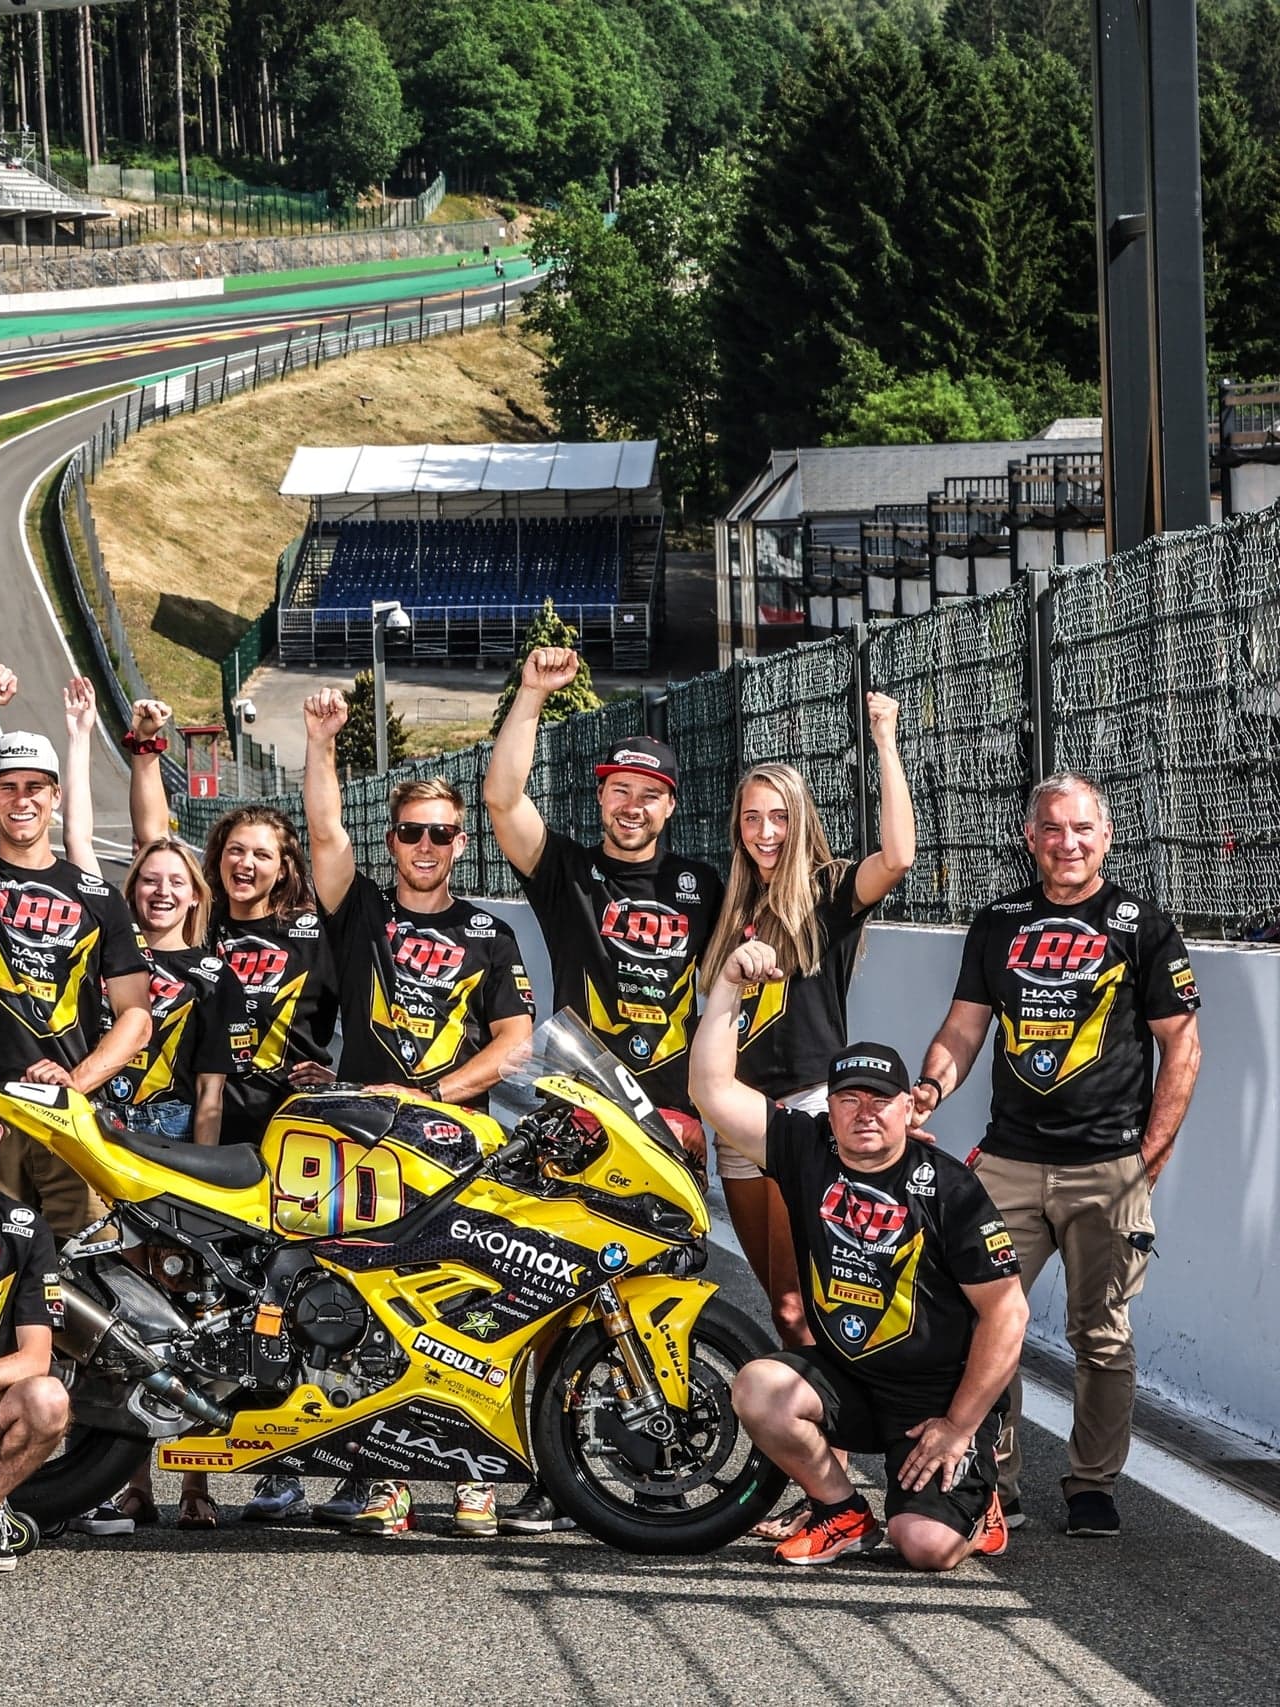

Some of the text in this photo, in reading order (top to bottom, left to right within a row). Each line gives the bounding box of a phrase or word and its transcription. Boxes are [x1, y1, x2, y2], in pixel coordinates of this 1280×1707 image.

[600, 900, 689, 948] LRP
[1019, 925, 1044, 934] team
[42, 934, 76, 948] Poland
[290, 930, 319, 938] PITBULL
[656, 947, 687, 958] Poland
[1006, 932, 1108, 969] LRP
[618, 961, 669, 982] HAAS
[1062, 972, 1099, 982] Poland
[420, 974, 455, 989] Poland
[1022, 988, 1078, 1004] HAAS
[1022, 1007, 1076, 1018] ms-eko
[1024, 1024, 1069, 1037] PIRELLI
[835, 1056, 892, 1073] PIRELLI
[614, 1065, 654, 1121] 9
[272, 1129, 405, 1239] 90
[609, 1174, 632, 1187] EWC
[450, 1219, 580, 1285] ekomax
[863, 1241, 897, 1255] Poland
[492, 1258, 577, 1297] RECYKLING
[521, 1286, 554, 1304] ms-eko
[834, 1283, 880, 1305] PIRELLI
[414, 1334, 487, 1378] PITBULL
[659, 1323, 687, 1386] PIRELLI
[255, 1423, 300, 1433] LORIZ
[231, 1438, 275, 1450] KOSA
[367, 1434, 451, 1470] Recykling Polska
[371, 1420, 509, 1481] HAAS
[163, 1450, 234, 1466] PIRELLI
